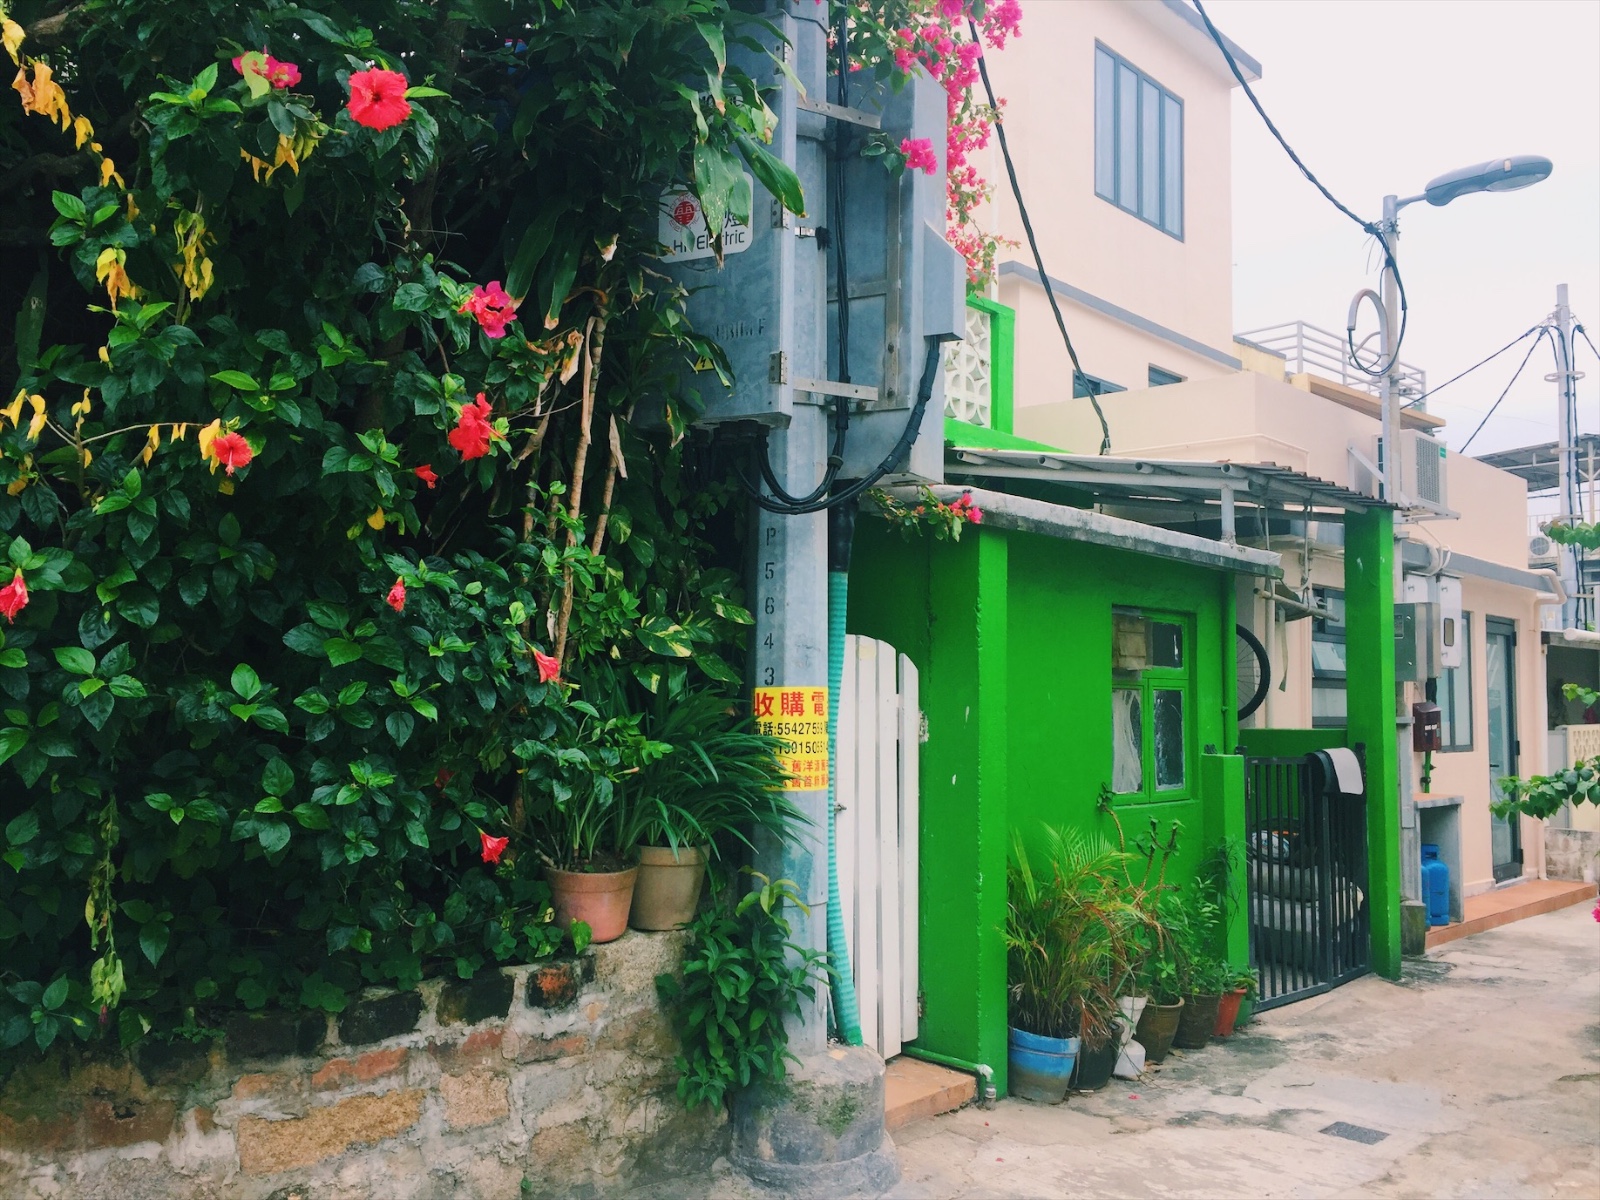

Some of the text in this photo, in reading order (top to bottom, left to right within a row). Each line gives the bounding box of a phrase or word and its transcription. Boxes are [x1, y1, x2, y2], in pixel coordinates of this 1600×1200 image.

[696, 229, 745, 250] Eltric
[753, 691, 825, 717] 收購電
